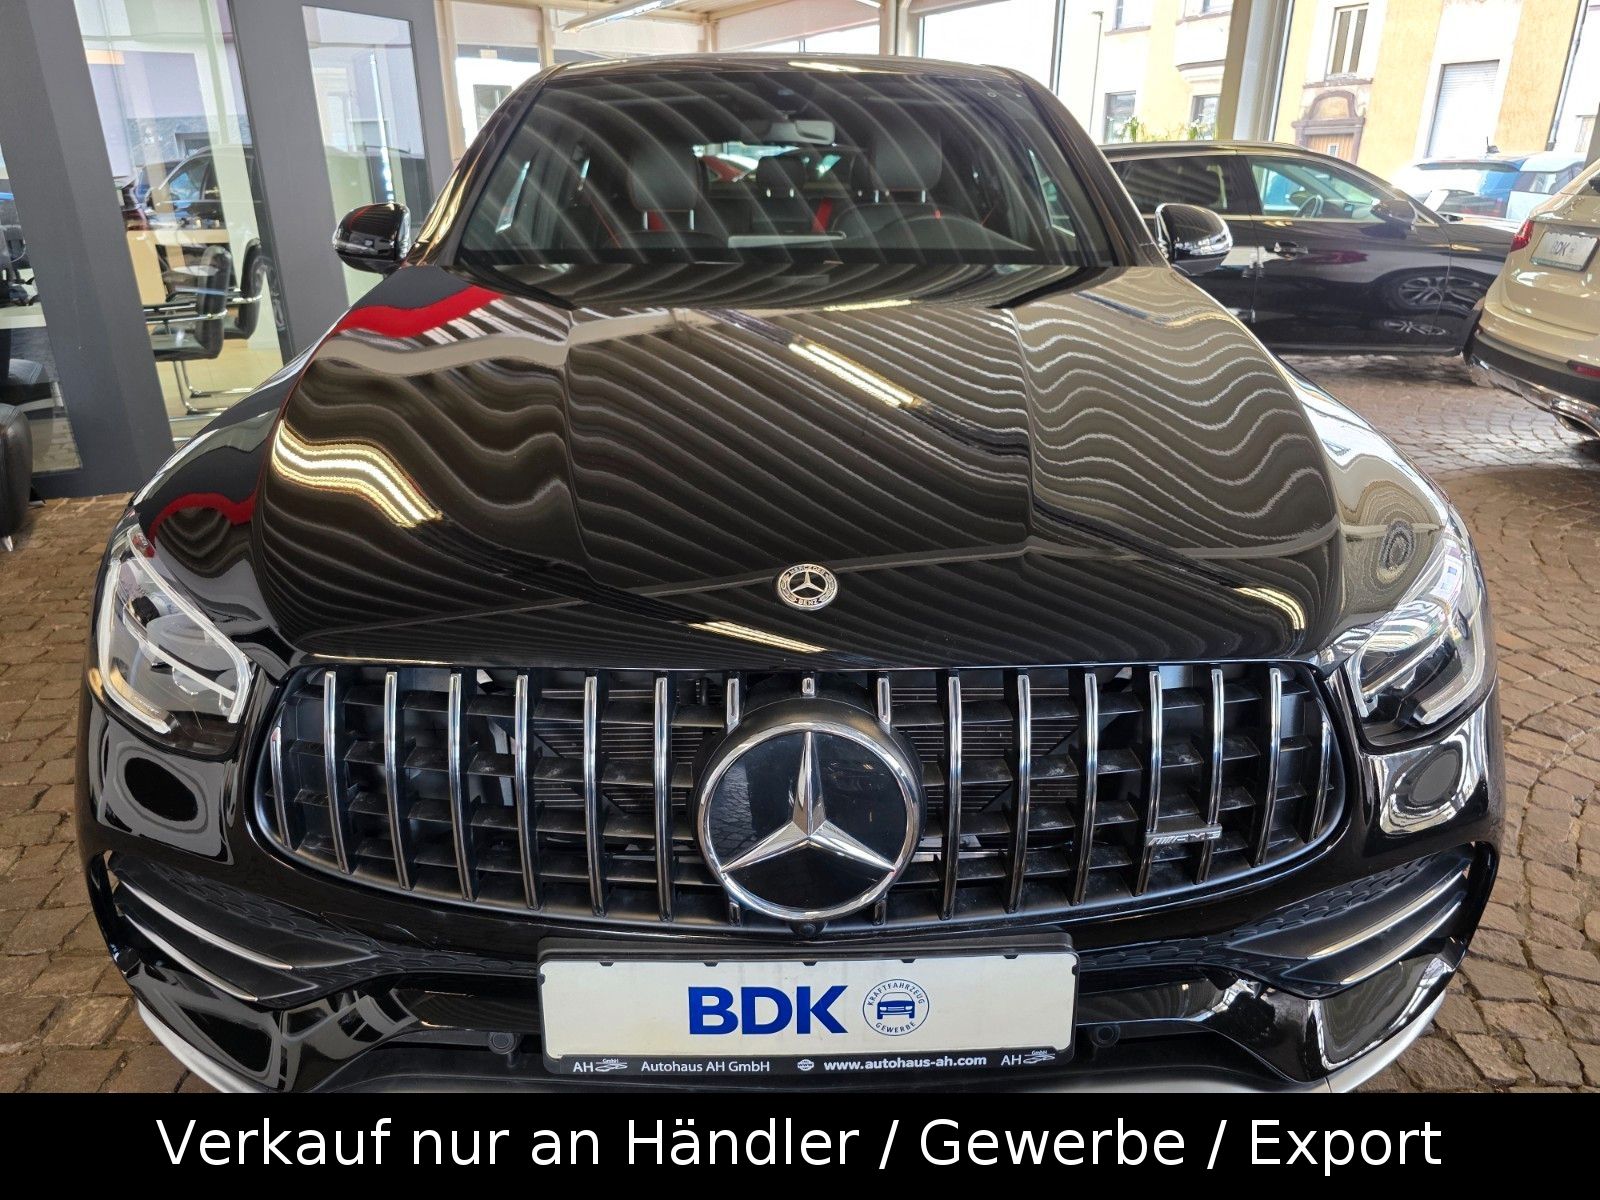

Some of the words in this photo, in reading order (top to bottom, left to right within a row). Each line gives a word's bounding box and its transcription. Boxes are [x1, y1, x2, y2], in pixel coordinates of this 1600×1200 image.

[866, 982, 926, 1006] KRAFTFAHRZEUG
[687, 985, 849, 1035] BDK
[875, 1021, 917, 1033] GEWERBE
[641, 1060, 703, 1073] Autohaus
[706, 1061, 725, 1072] AH
[728, 1060, 770, 1072] GmbH
[823, 1055, 988, 1071] www.autohaus-ah.com
[1000, 1054, 1022, 1066] AH
[572, 1061, 594, 1073] AH
